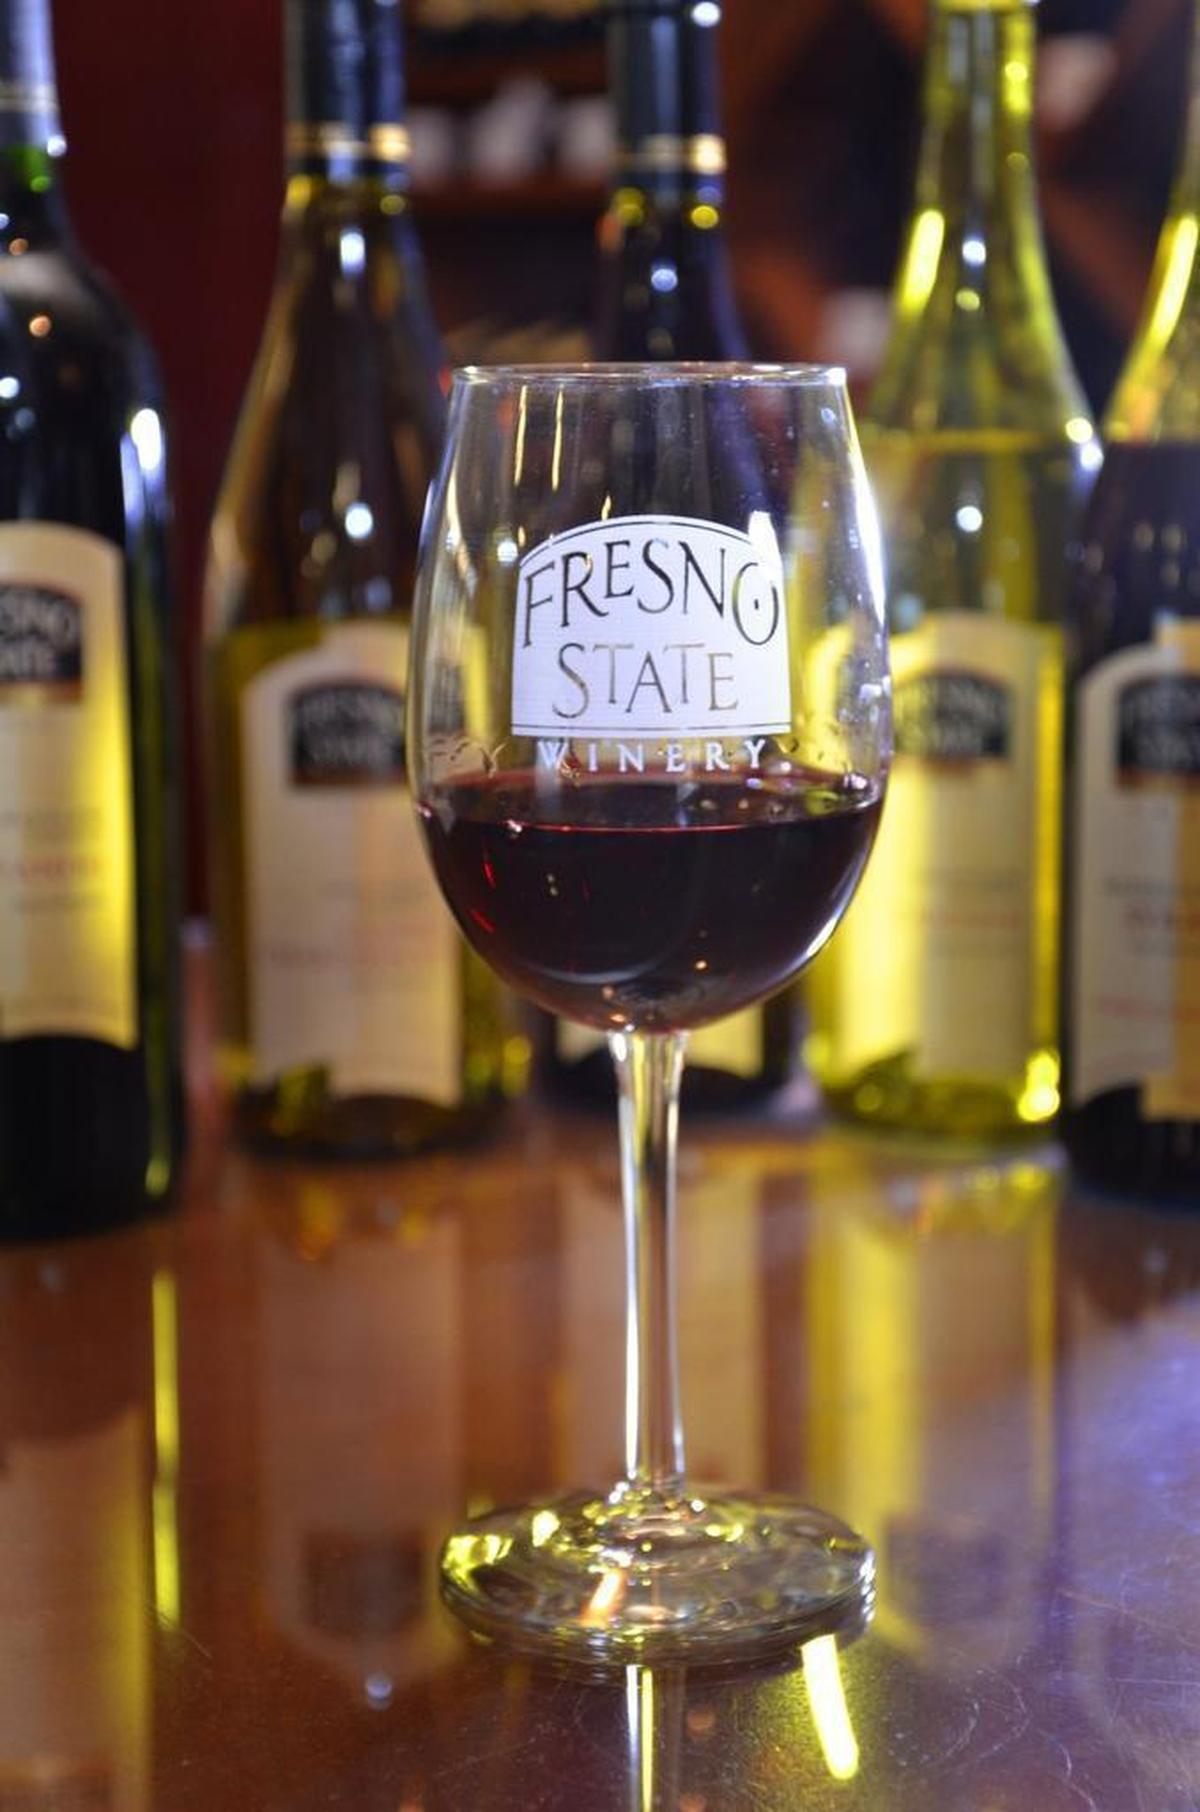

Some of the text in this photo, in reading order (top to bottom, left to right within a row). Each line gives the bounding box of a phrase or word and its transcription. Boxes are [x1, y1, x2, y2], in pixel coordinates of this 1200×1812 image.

[522, 539, 780, 646] FRESNO
[552, 642, 739, 719] STATE
[537, 739, 766, 772] WINERY
